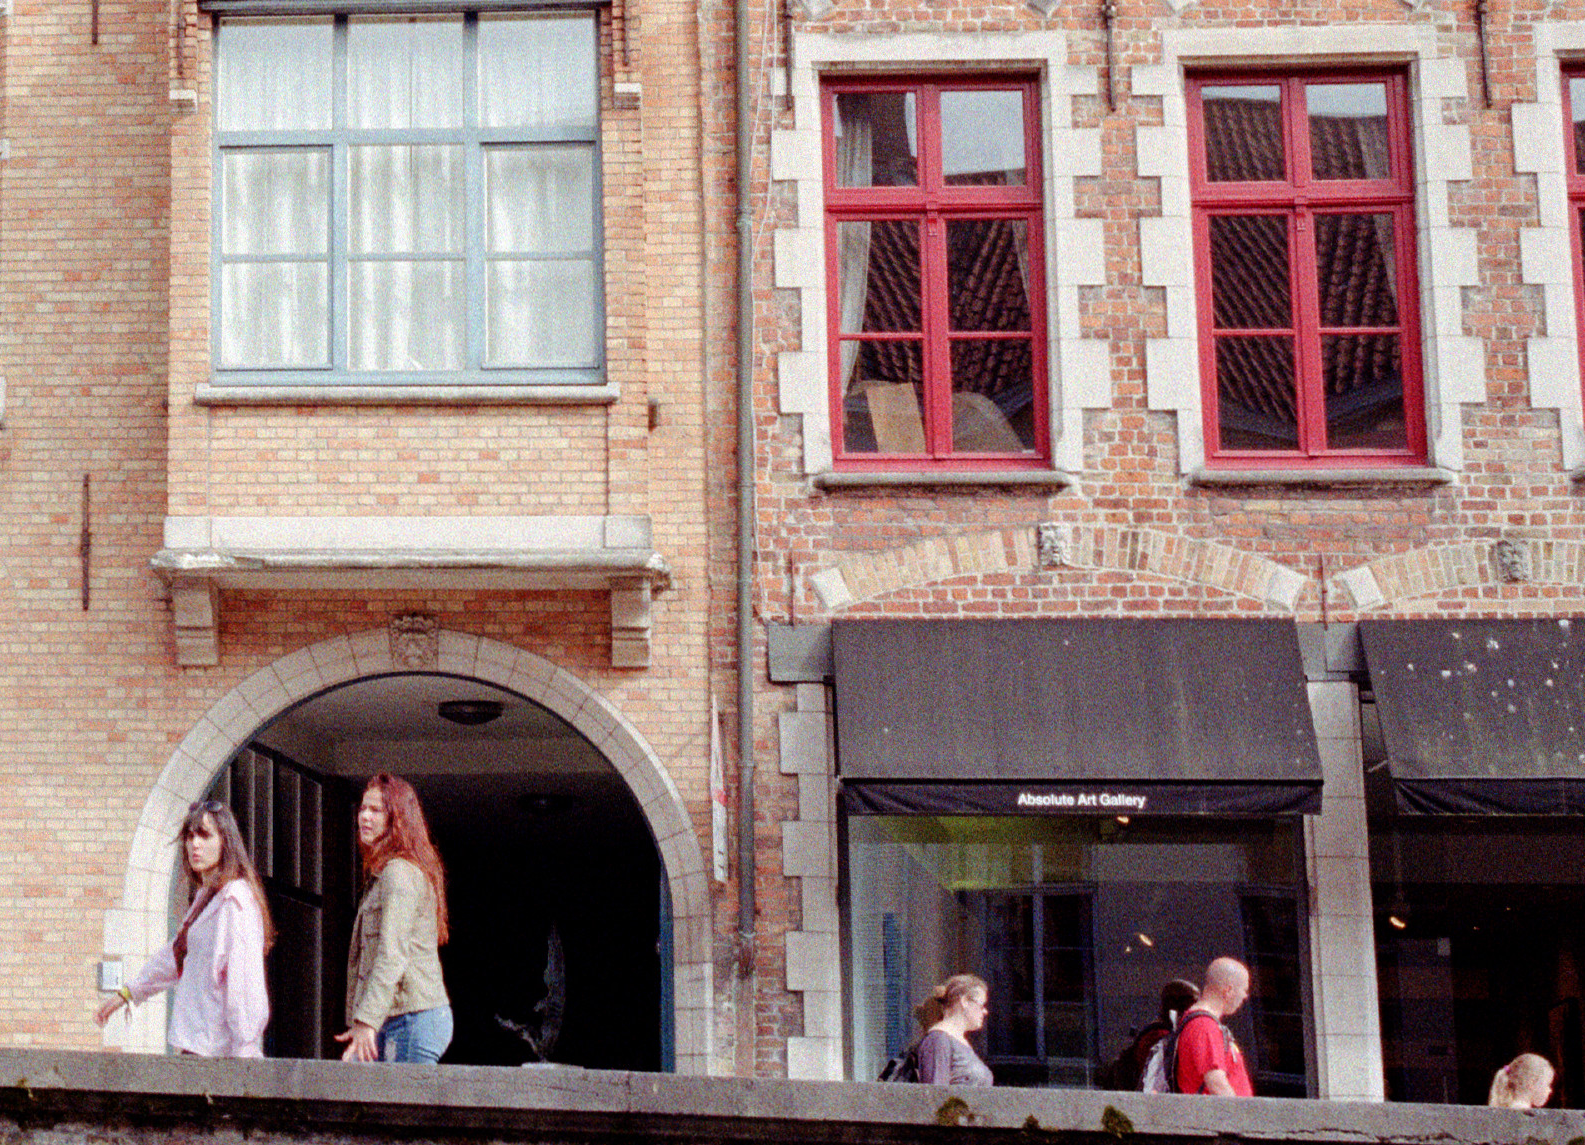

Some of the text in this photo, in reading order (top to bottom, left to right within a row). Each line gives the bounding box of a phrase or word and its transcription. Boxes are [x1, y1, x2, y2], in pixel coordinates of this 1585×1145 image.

[1017, 793, 1146, 809] Absolute Art Gallery
